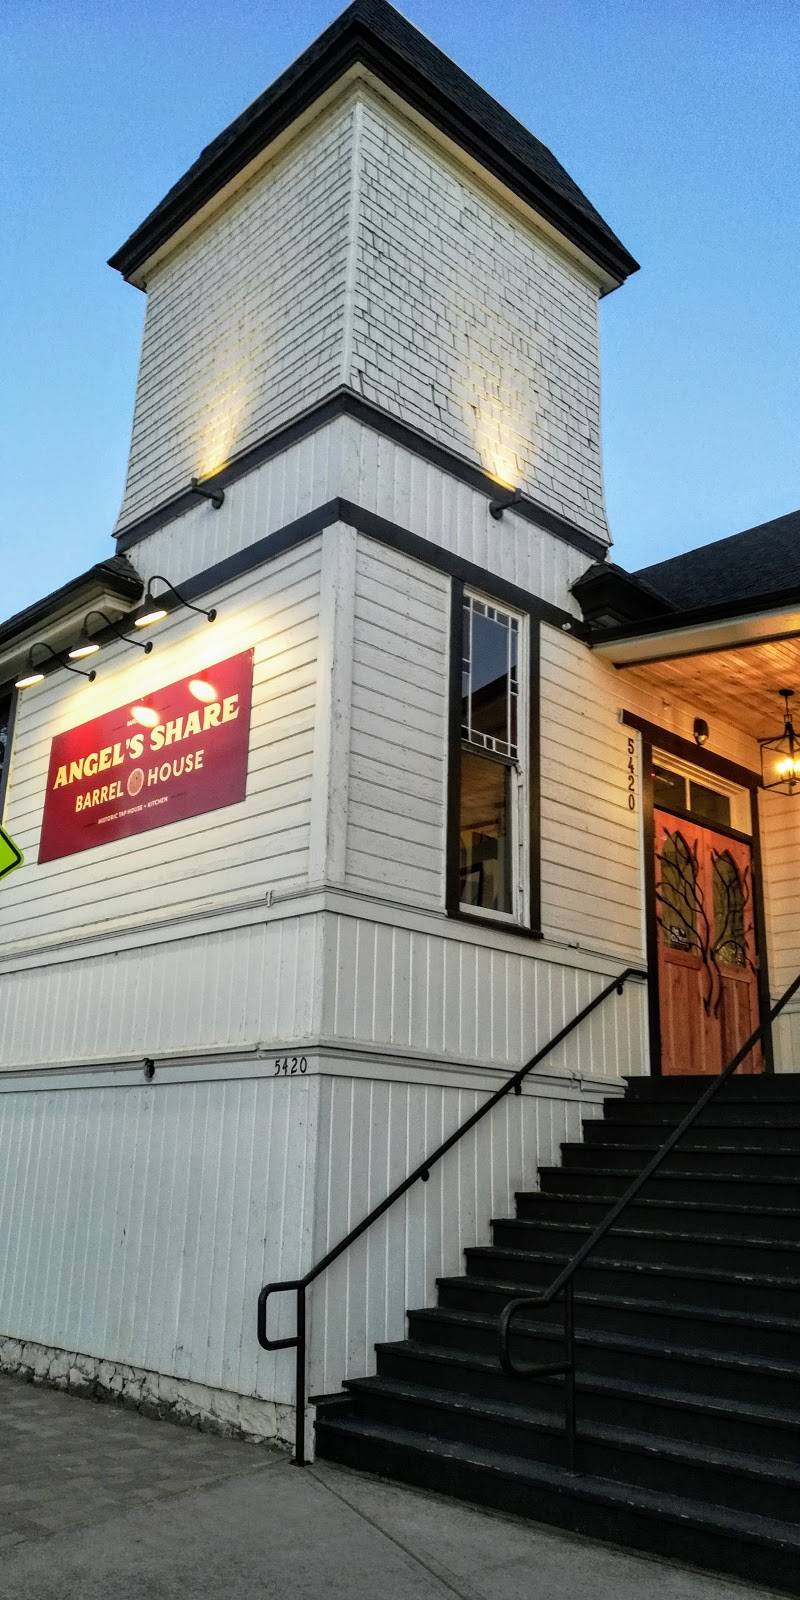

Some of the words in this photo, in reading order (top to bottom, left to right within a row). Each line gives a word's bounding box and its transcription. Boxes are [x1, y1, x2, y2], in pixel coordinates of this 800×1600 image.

[53, 734, 144, 790] ANGEL'S
[150, 694, 239, 751] SHARE
[75, 781, 124, 813] BARREL
[147, 750, 205, 787] HOUSE
[274, 1057, 307, 1076] 5420
